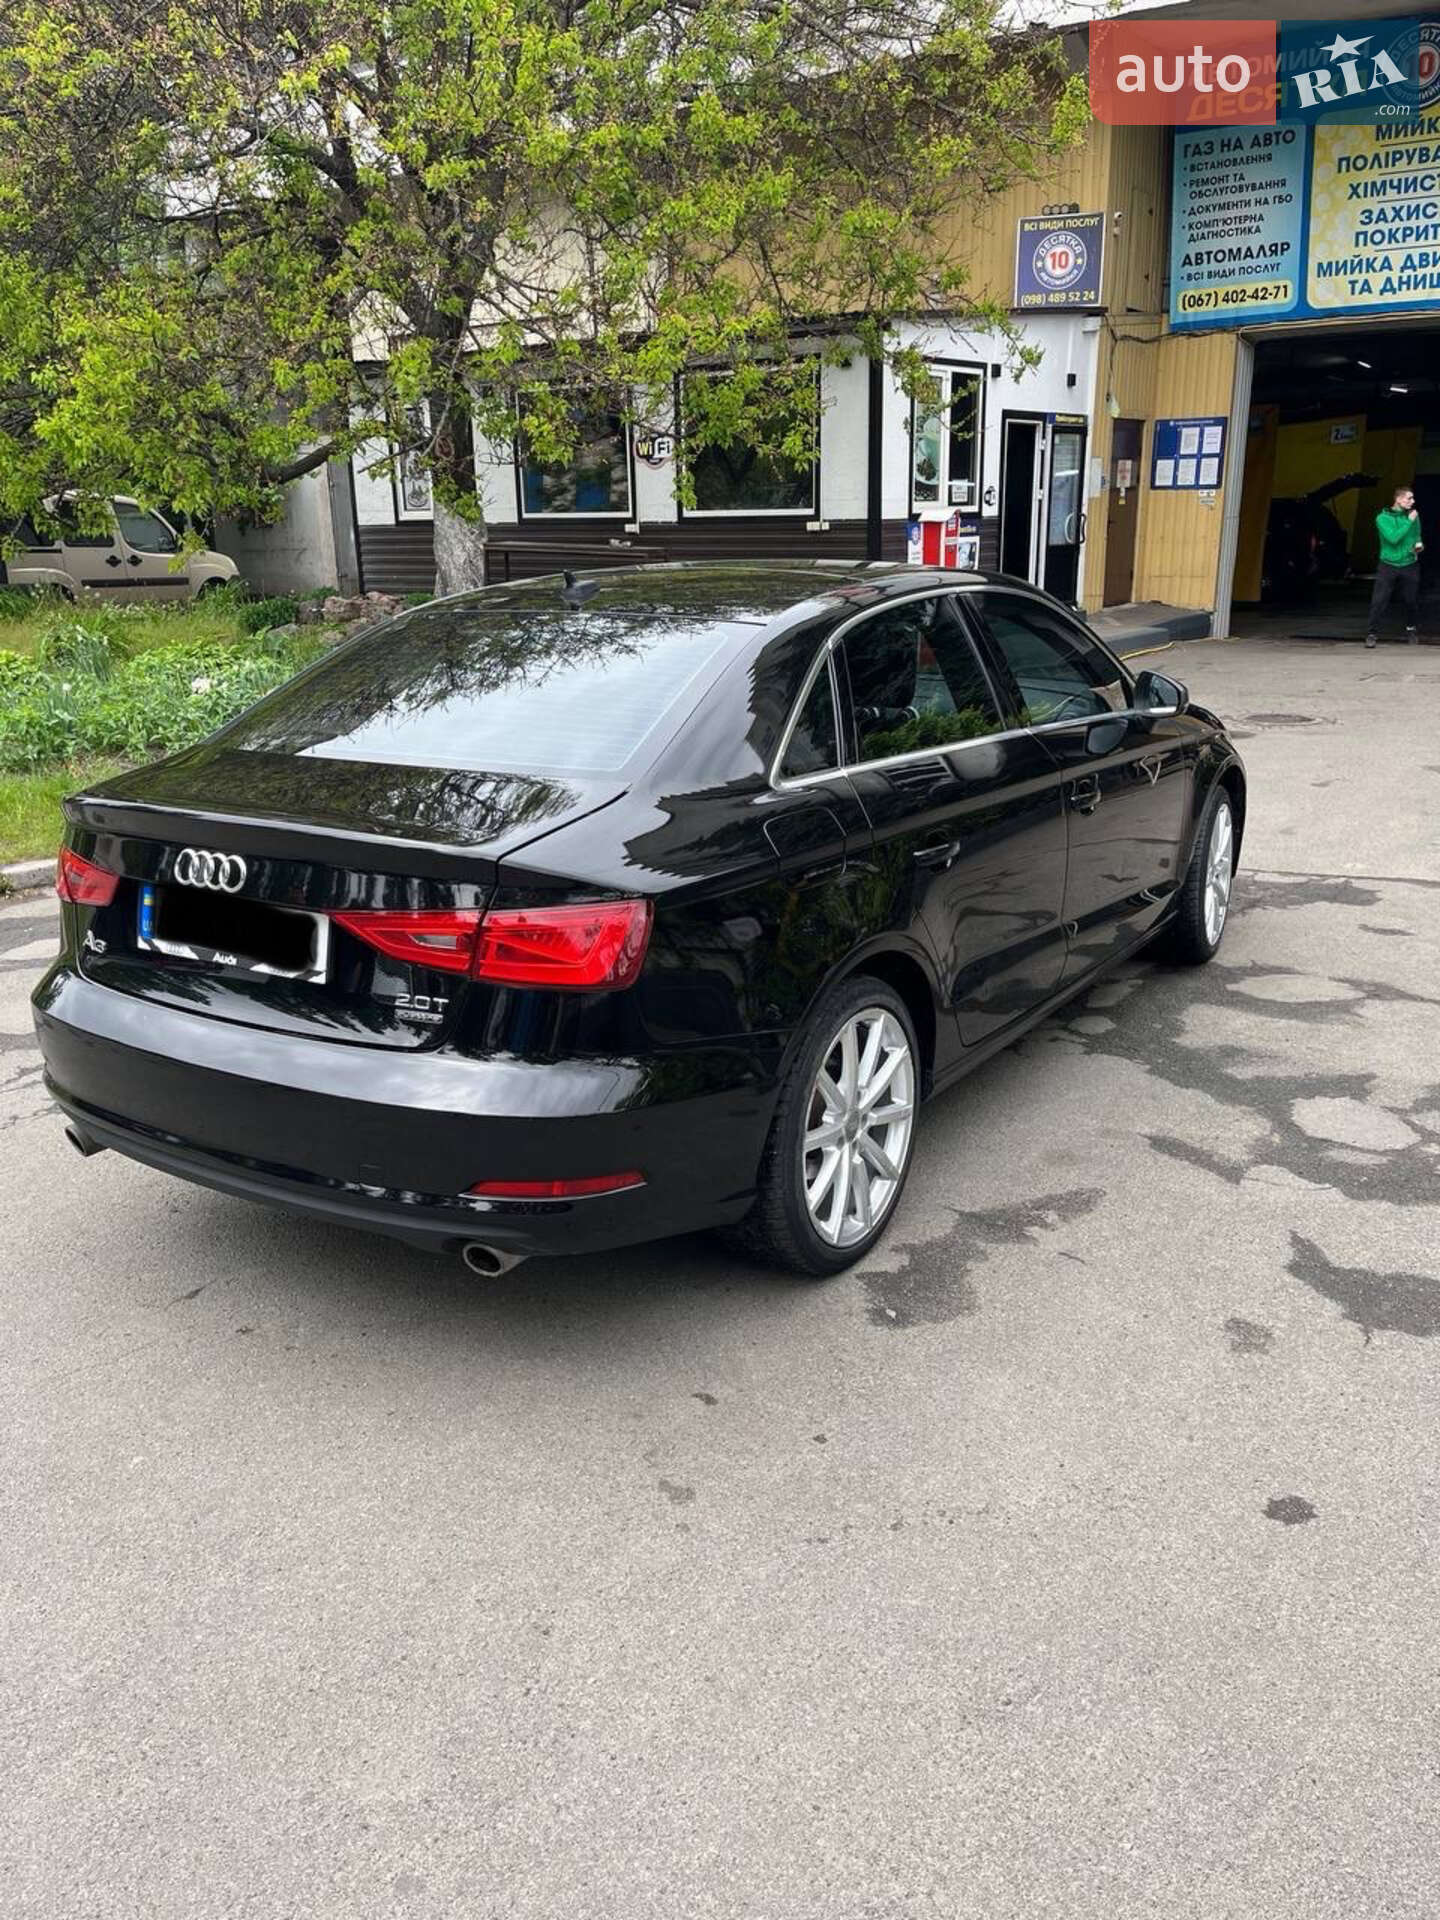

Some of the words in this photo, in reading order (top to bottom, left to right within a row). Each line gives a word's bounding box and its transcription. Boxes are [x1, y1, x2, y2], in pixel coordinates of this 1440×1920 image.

[1183, 141, 1215, 159] ГАЗ
[1220, 136, 1244, 153] НА
[1249, 129, 1297, 149] АВТО
[1190, 152, 1273, 173] ВСТАНОВЛЕННЯ
[1189, 174, 1230, 188] РЕМОНТ
[1233, 172, 1246, 182] ТА
[1189, 178, 1287, 200] ОБСЛУГОВУВАННЯ
[1187, 199, 1252, 217] ДОКУМЕНТИ
[1255, 196, 1270, 206] НА
[1273, 193, 1293, 205] ГБО
[1039, 220, 1064, 230] ВИДИ
[1066, 217, 1099, 228] ПОСЛУГ
[1187, 225, 1262, 244] ДІАГНОСТИКА
[1050, 250, 1070, 270] 10
[1181, 241, 1292, 268] АВТОМАЛЯР
[1186, 272, 1204, 282] ВСІ
[1207, 268, 1236, 280] ВИДИ
[1239, 262, 1282, 276] ПОСЛУГ
[1317, 254, 1393, 279] МИЙКА
[1068, 291, 1080, 301] 52
[1083, 290, 1094, 300] 24
[1348, 278, 1373, 296] ТА
[1181, 290, 1219, 312] (067)
[1221, 284, 1289, 305] 402-42-71
[83, 929, 107, 953] A3
[213, 951, 237, 966] Audi
[394, 992, 450, 1012] 2.0T
